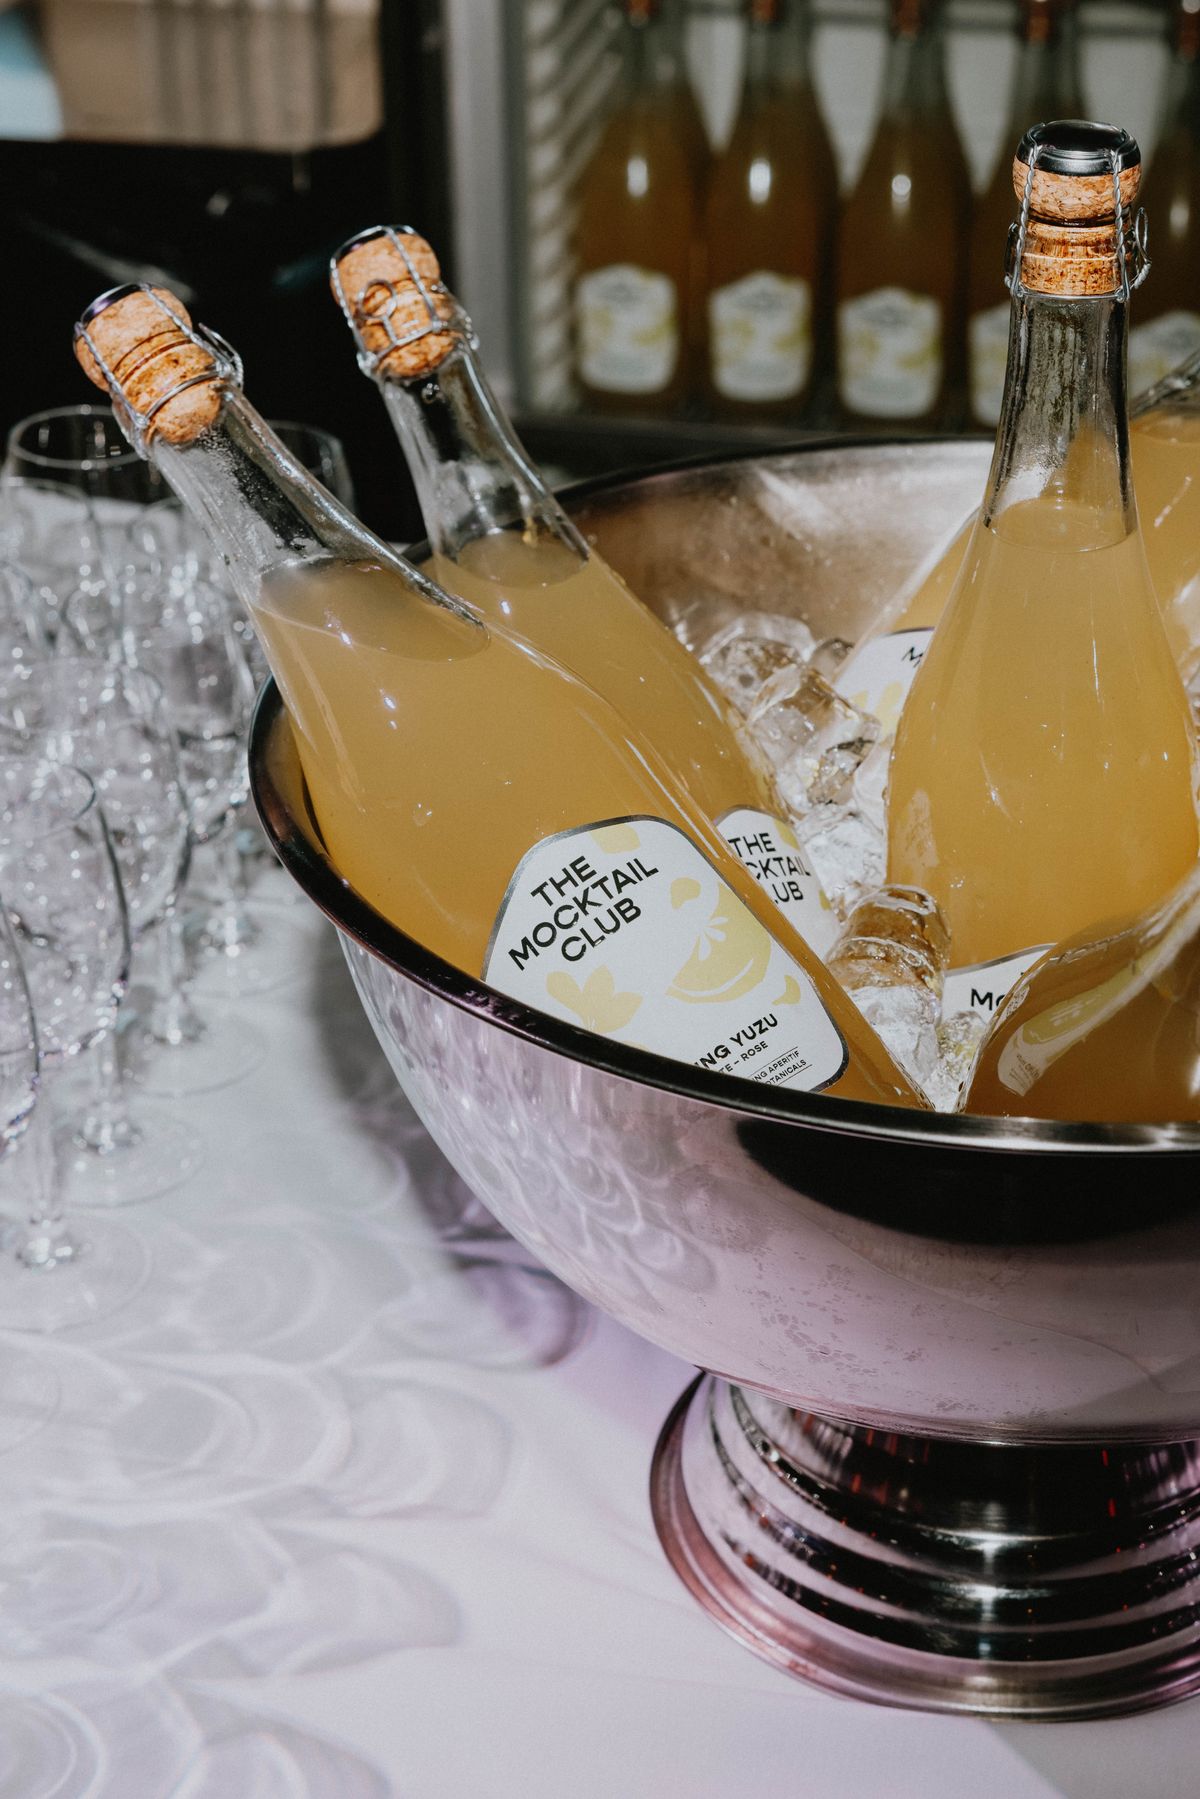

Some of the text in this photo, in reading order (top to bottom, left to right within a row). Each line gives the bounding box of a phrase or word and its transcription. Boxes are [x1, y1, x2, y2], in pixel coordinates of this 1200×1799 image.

[728, 832, 776, 858] THE
[531, 855, 597, 908] THE
[773, 880, 804, 904] UB
[508, 856, 660, 972] MOCKTAIL
[560, 897, 643, 963] CLUB
[694, 1013, 778, 1069] NG YUZU
[741, 1040, 769, 1062] ROSE
[768, 1050, 801, 1073] APERITIF
